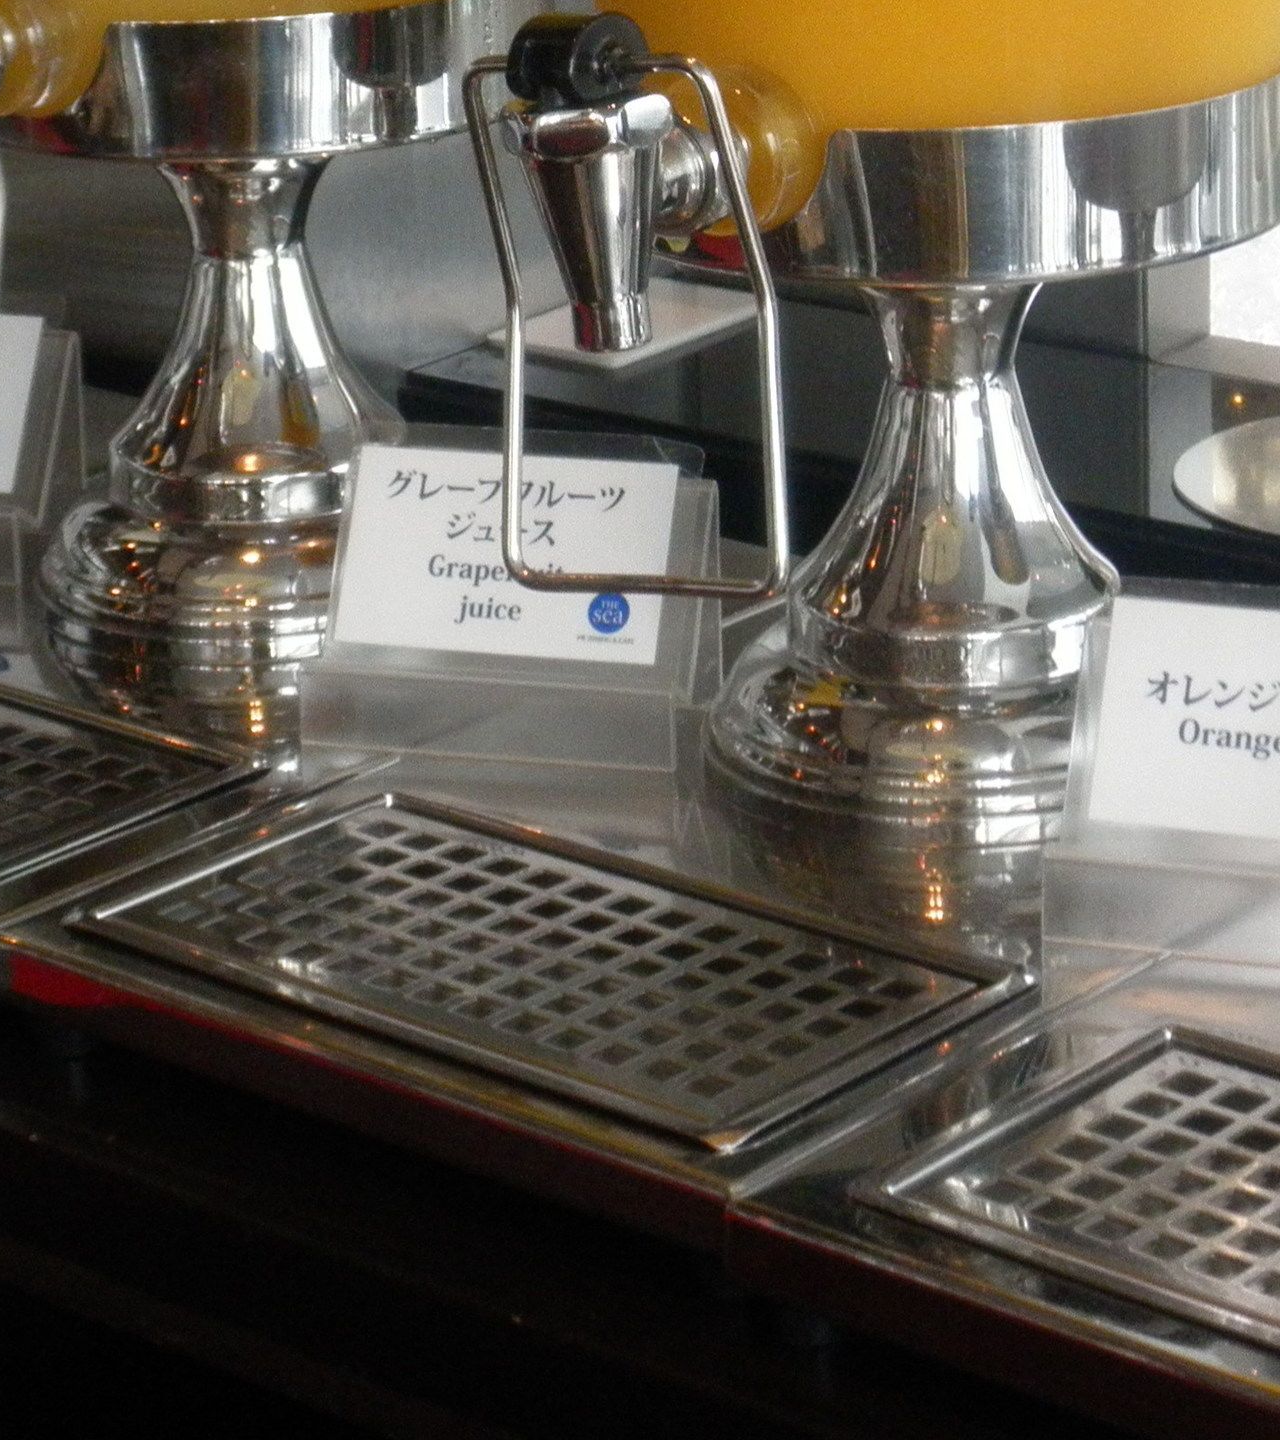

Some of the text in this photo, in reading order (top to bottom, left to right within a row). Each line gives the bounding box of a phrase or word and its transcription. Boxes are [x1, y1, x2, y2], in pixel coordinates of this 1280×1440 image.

[446, 512, 555, 547] ジュス
[454, 595, 521, 624] juice
